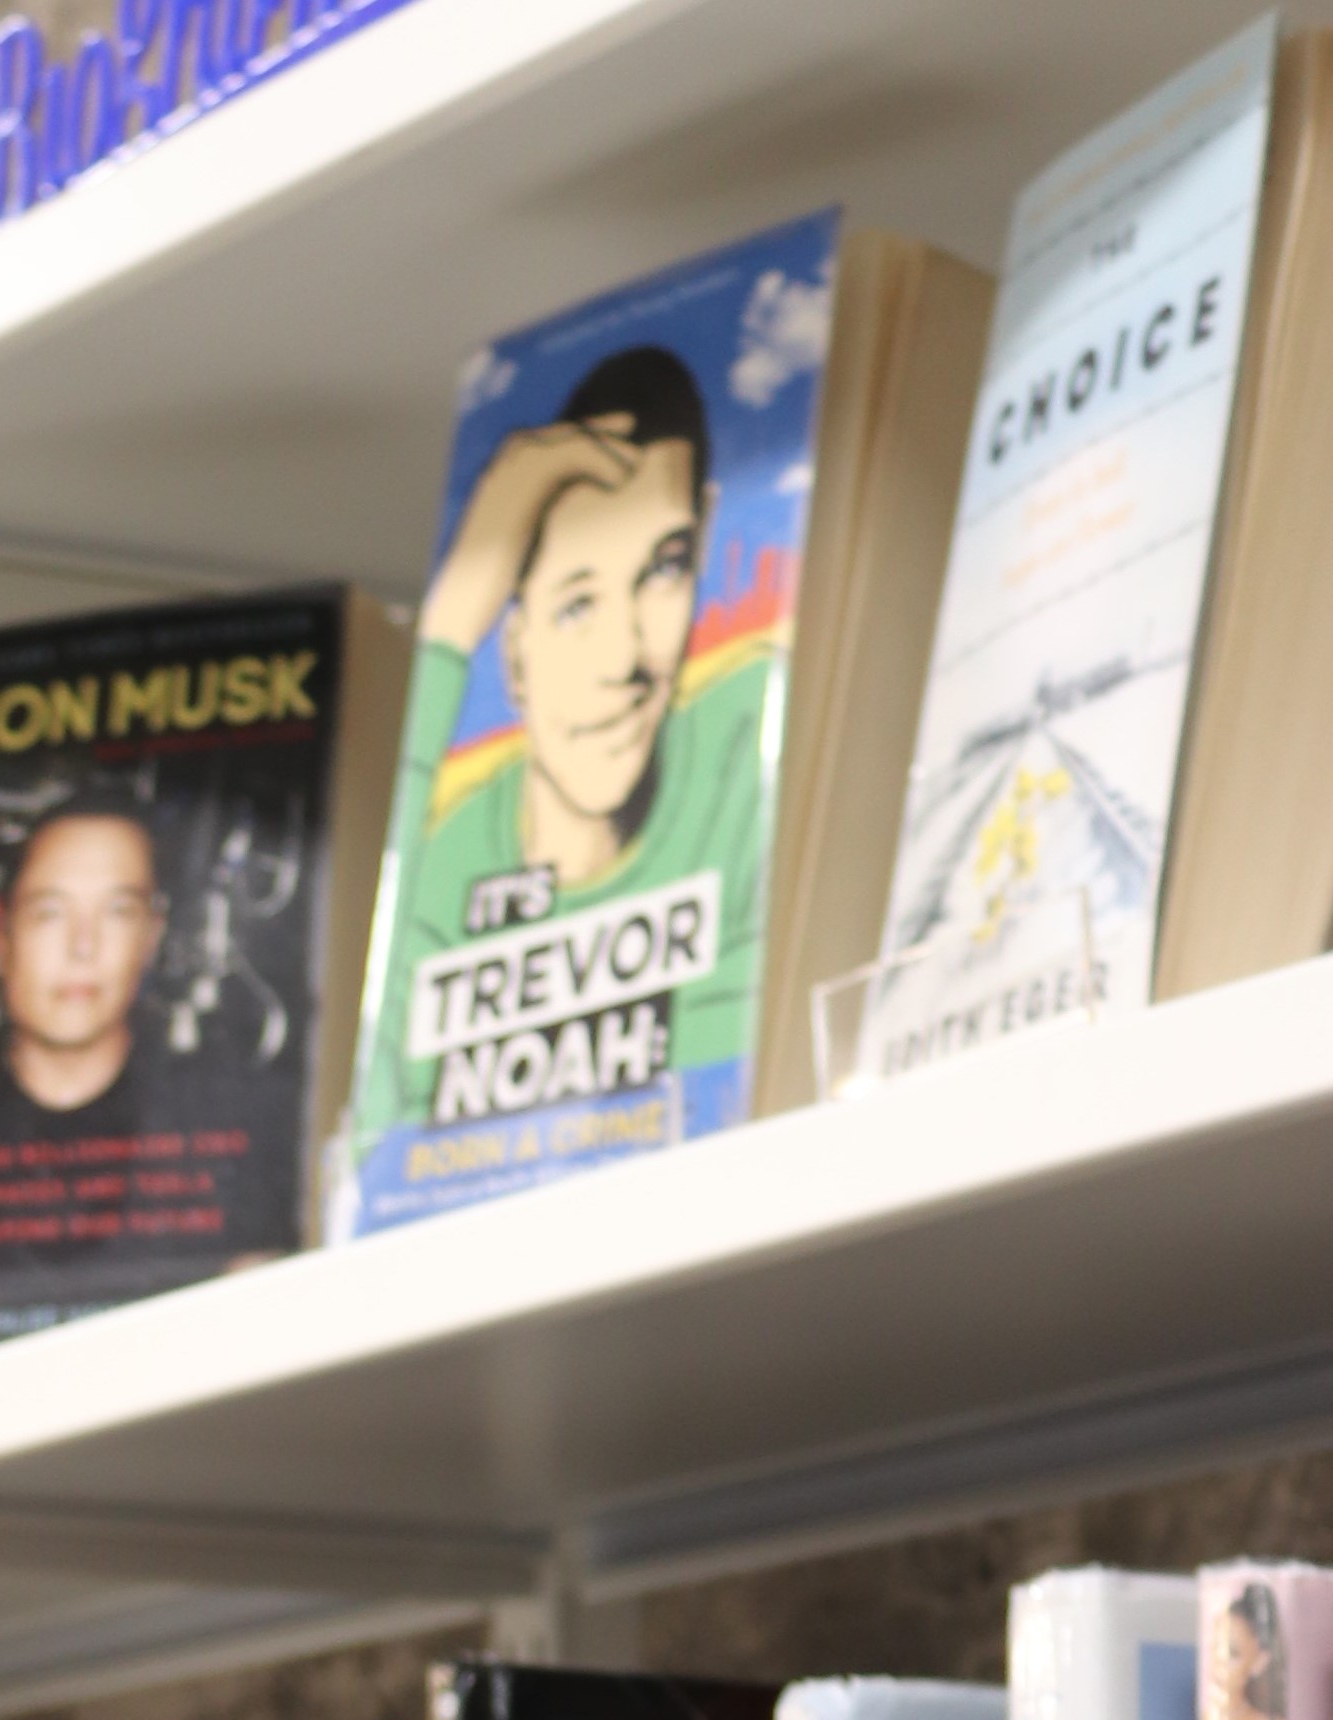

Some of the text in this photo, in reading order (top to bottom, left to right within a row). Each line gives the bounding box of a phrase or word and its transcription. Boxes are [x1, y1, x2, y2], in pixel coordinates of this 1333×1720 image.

[987, 274, 1223, 466] CHOICE
[108, 651, 319, 736] MUSK
[467, 868, 555, 931] IT'S
[432, 898, 704, 1036] TREVOR
